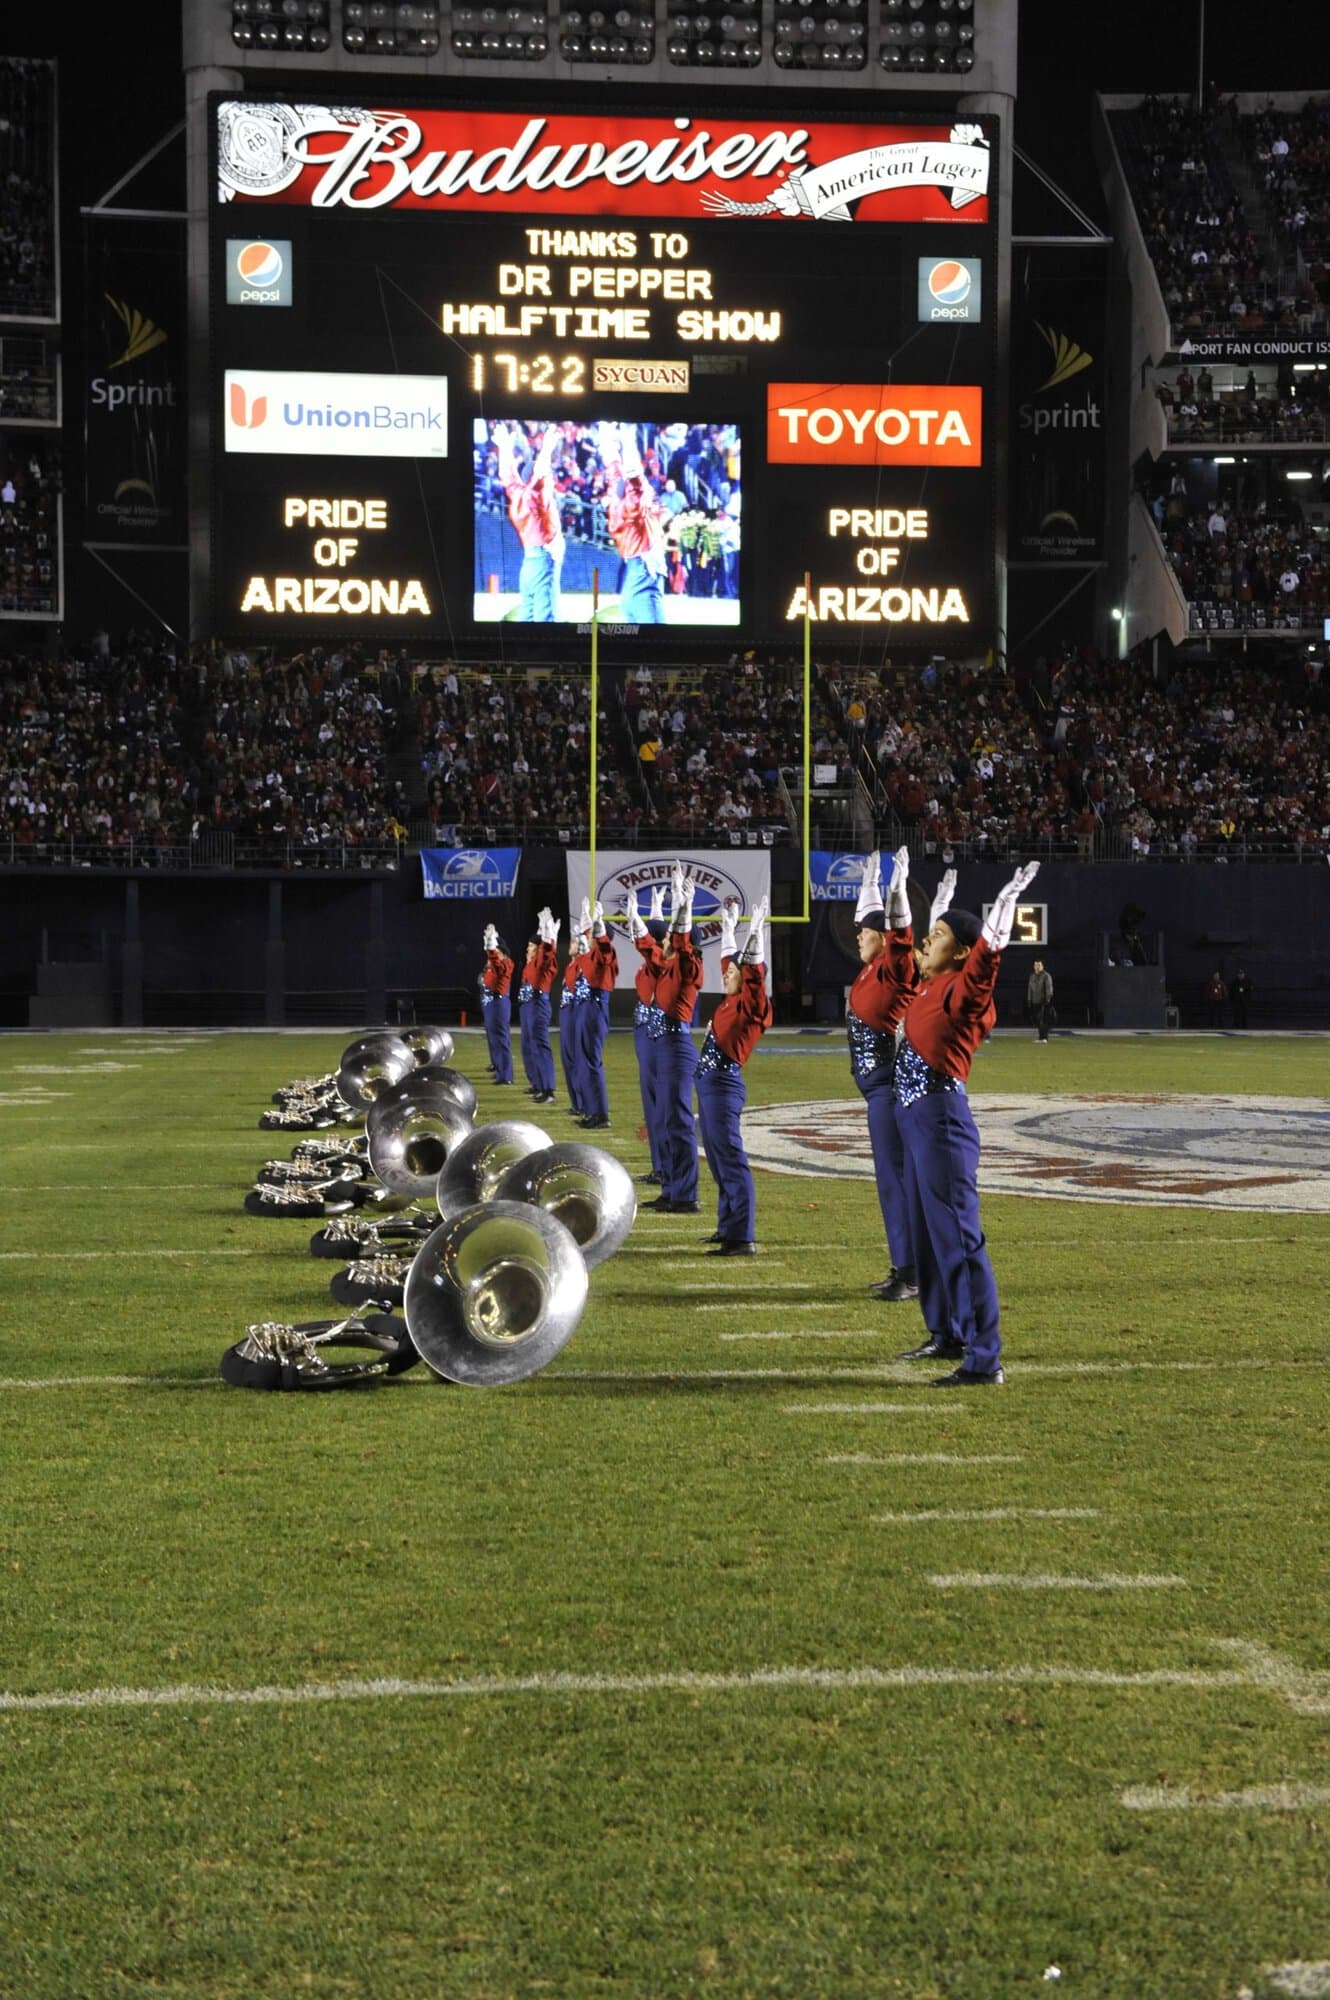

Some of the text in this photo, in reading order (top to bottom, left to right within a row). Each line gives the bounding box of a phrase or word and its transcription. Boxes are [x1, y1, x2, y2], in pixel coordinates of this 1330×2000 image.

[287, 117, 809, 208] Budweiser
[816, 156, 983, 204] American Lager
[526, 230, 688, 258] THANKS TO
[240, 290, 280, 303] pepsi
[500, 264, 713, 300] DR PEPPER
[442, 303, 781, 342] HALFTIME SHOW
[931, 306, 969, 320] pepsi
[1226, 343, 1251, 355] FAN
[1254, 342, 1313, 354] CONDUCT
[473, 353, 585, 393] 17:22
[596, 366, 689, 385] SYCUAN
[91, 378, 176, 411] Sprint
[283, 402, 442, 430] UnionBank
[778, 408, 972, 446] TOYOTA
[1018, 403, 1100, 435] Sprint
[285, 499, 387, 529] PRIDE
[829, 508, 928, 538] PRIDE
[314, 538, 358, 567] OF
[856, 547, 899, 575] OF
[240, 577, 431, 615] ARIZONA
[785, 586, 970, 622] ARIZONA
[1017, 907, 1038, 941] 5
